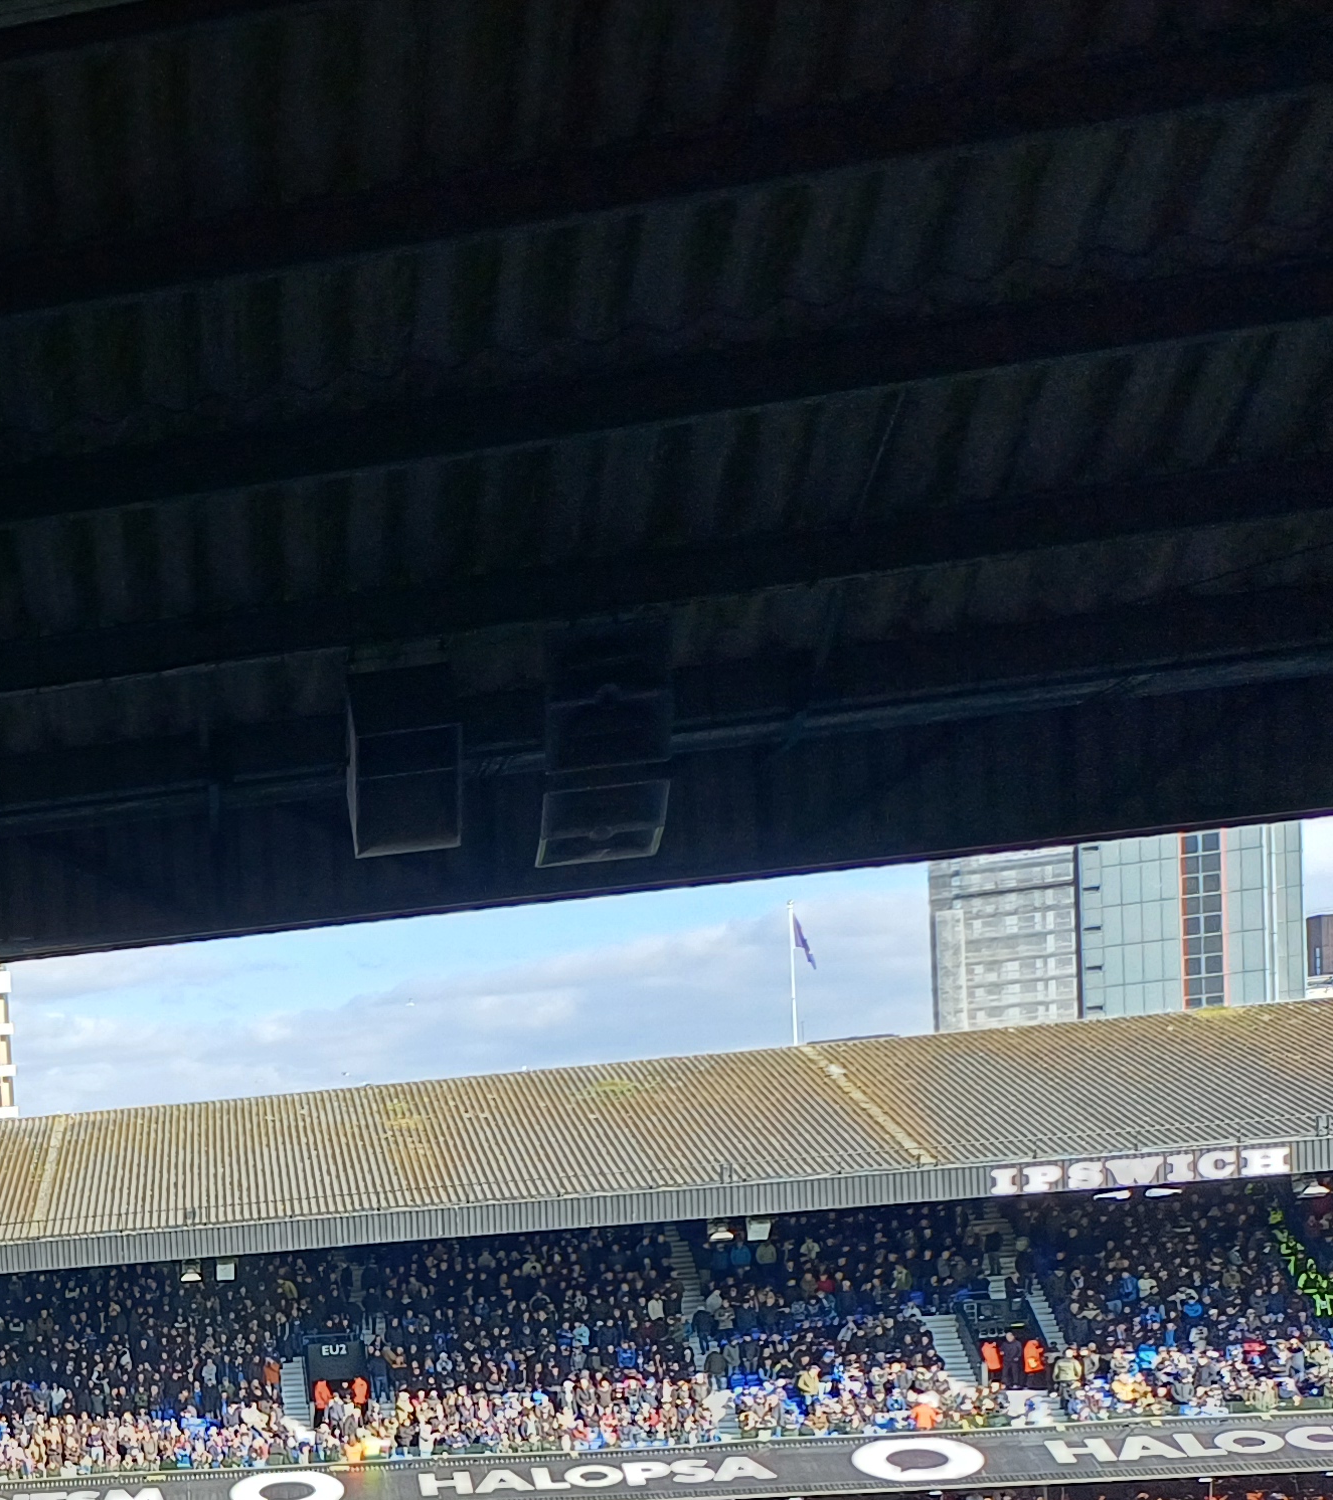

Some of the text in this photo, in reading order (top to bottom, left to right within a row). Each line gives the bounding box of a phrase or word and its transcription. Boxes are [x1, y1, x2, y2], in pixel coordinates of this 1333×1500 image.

[990, 1147, 1290, 1195] IPSWICH
[321, 1344, 347, 1356] EU2
[418, 1455, 779, 1498] HALOPSA
